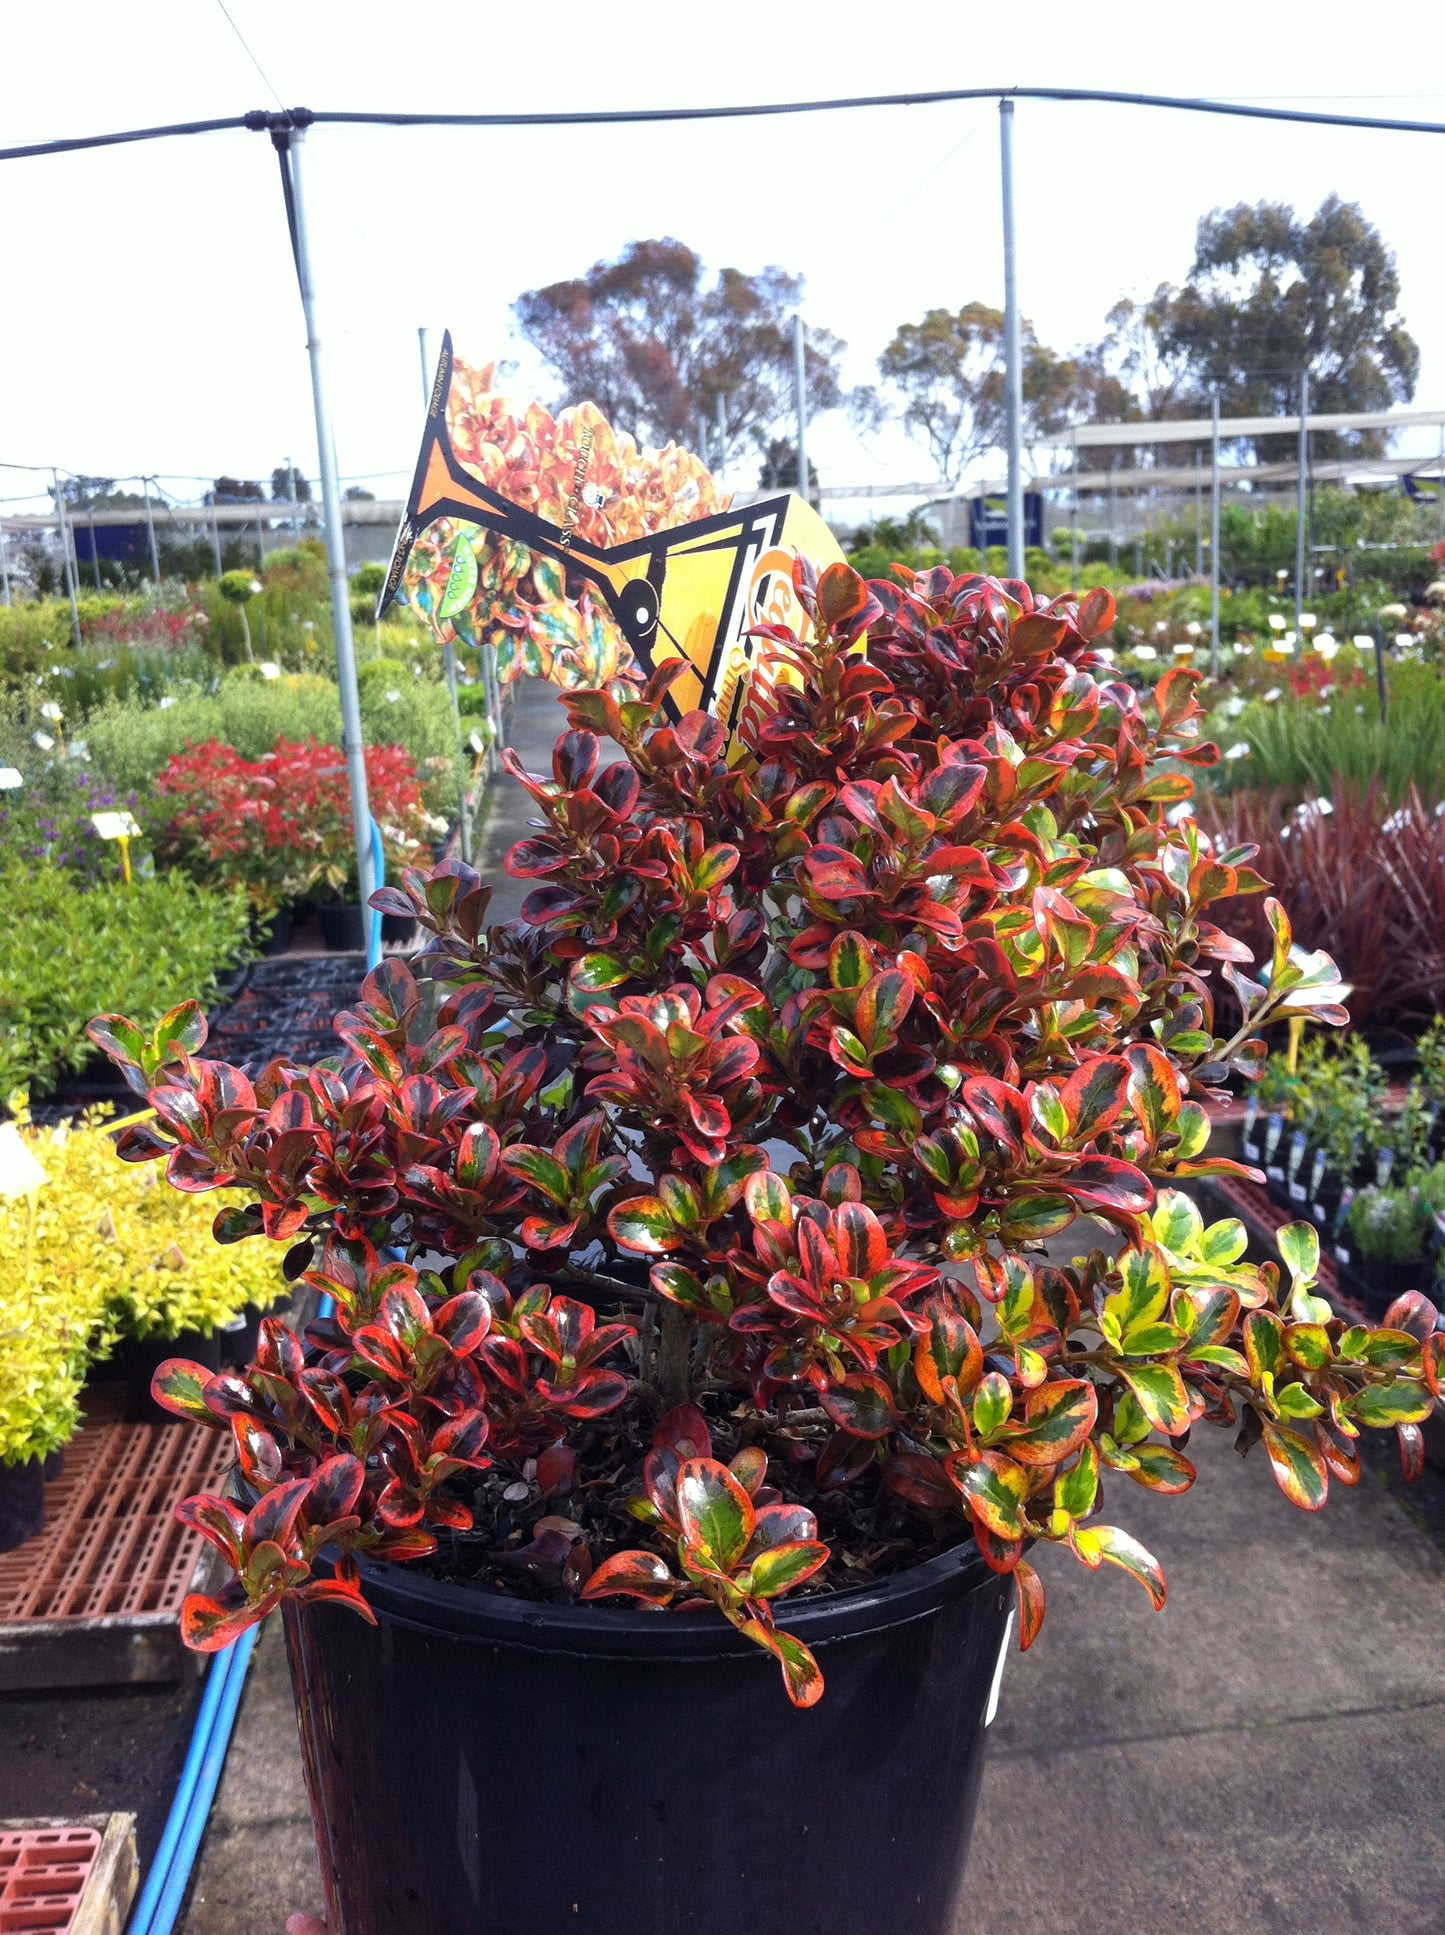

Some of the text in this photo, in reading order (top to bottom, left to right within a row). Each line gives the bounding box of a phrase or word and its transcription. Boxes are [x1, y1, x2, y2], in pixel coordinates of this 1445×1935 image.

[429, 349, 450, 419] AUTUMN FOLIAGE
[573, 427, 595, 482] TOUCH
[559, 495, 580, 547] CLASS
[388, 555, 403, 591] FOLIAGE
